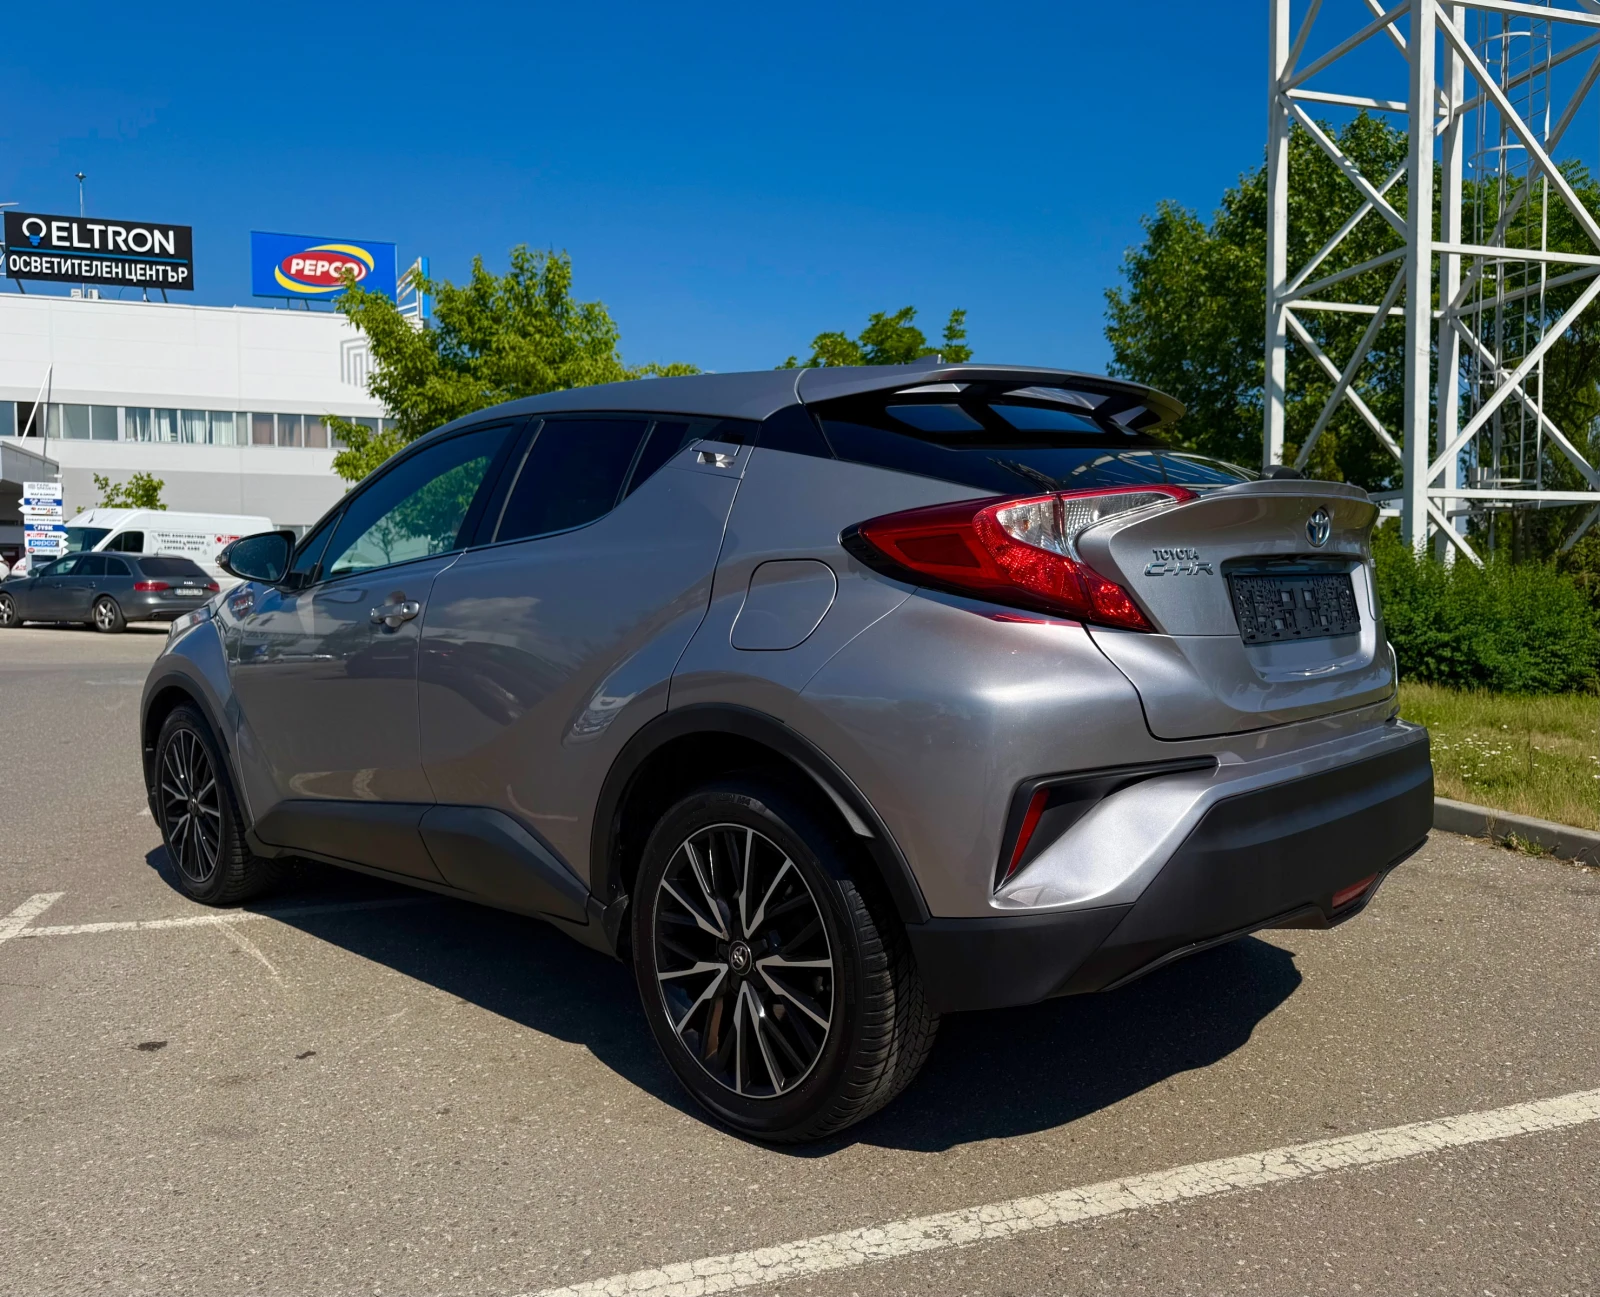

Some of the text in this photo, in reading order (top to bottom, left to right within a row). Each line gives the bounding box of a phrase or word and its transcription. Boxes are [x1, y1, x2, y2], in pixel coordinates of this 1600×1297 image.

[51, 220, 175, 255] ELTRON
[9, 254, 188, 283] ОСВЕТИТЕЛЕН ЦЕНТЪР
[1152, 548, 1200, 561] TOYOTA
[1143, 562, 1214, 576] C-HR
